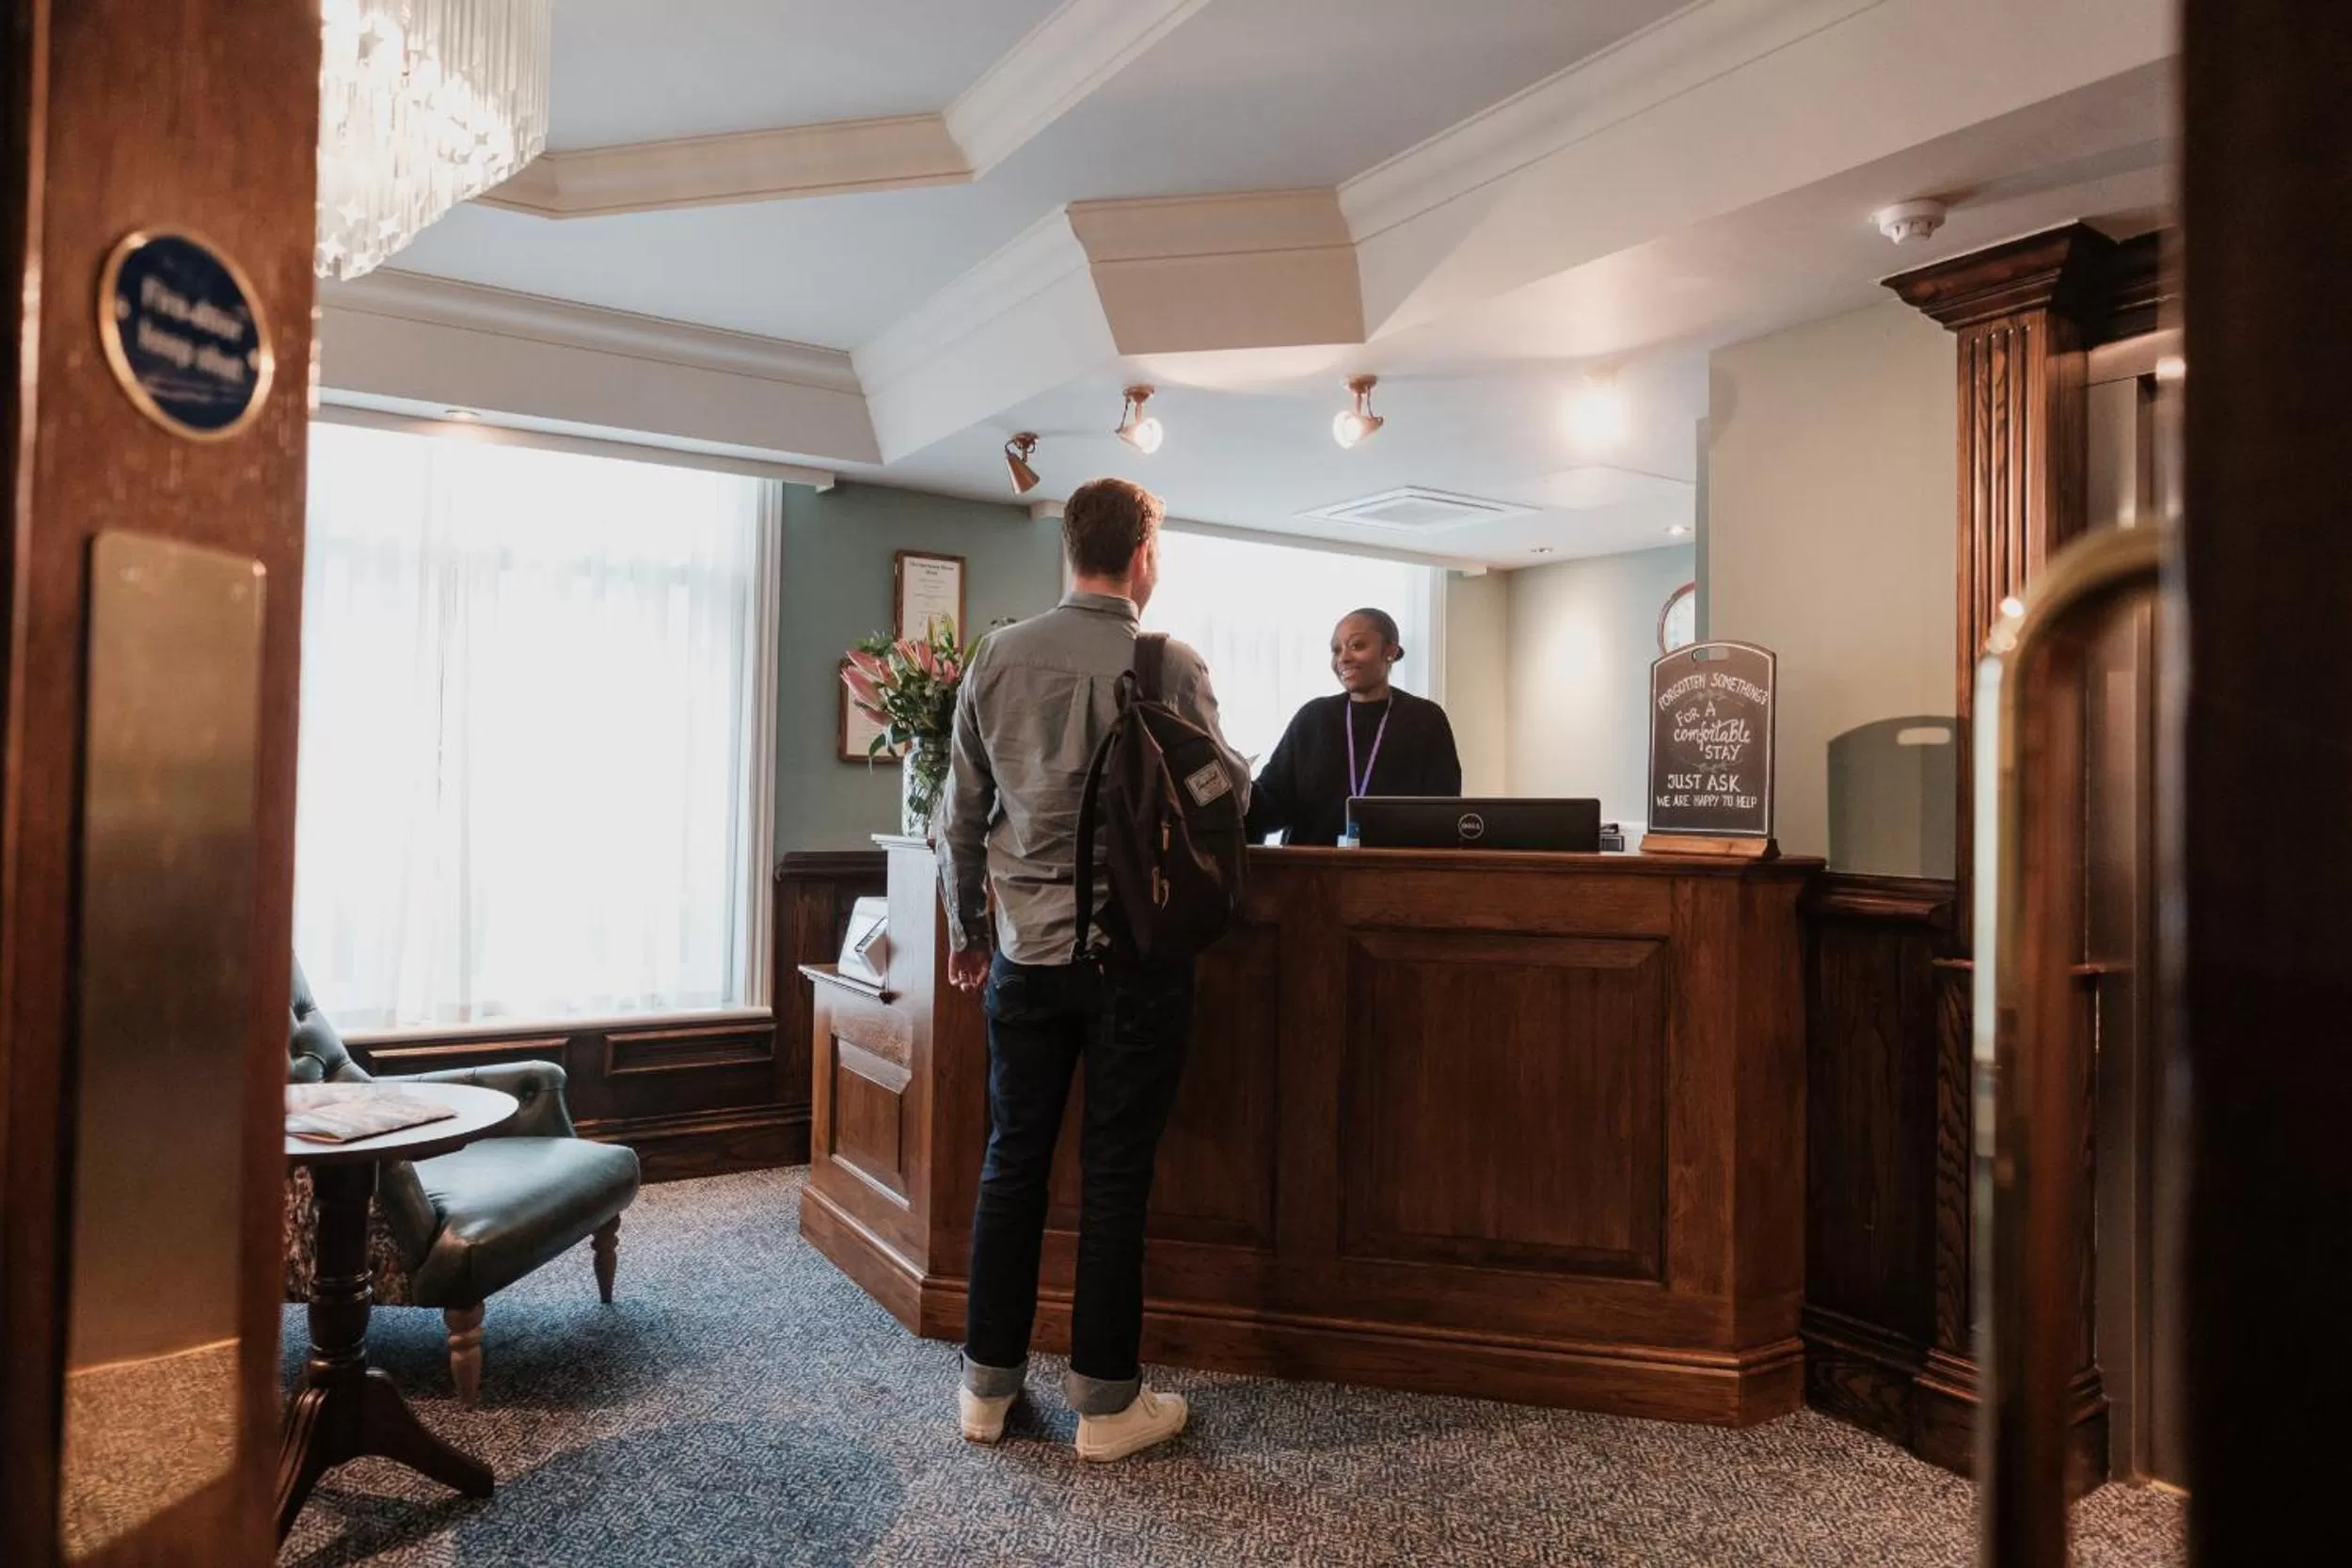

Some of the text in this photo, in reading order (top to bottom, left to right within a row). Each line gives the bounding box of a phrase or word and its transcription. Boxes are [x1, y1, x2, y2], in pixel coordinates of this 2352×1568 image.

[1658, 673, 1769, 711] FORGOTTEN SOMETHING?
[1705, 700, 1716, 717] A
[1674, 719, 1751, 752] comfortable
[1705, 744, 1742, 761] STAY
[1667, 773, 1741, 793] JUST ASK
[1657, 794, 1757, 809] WE ARE HAPPY TO HELP
